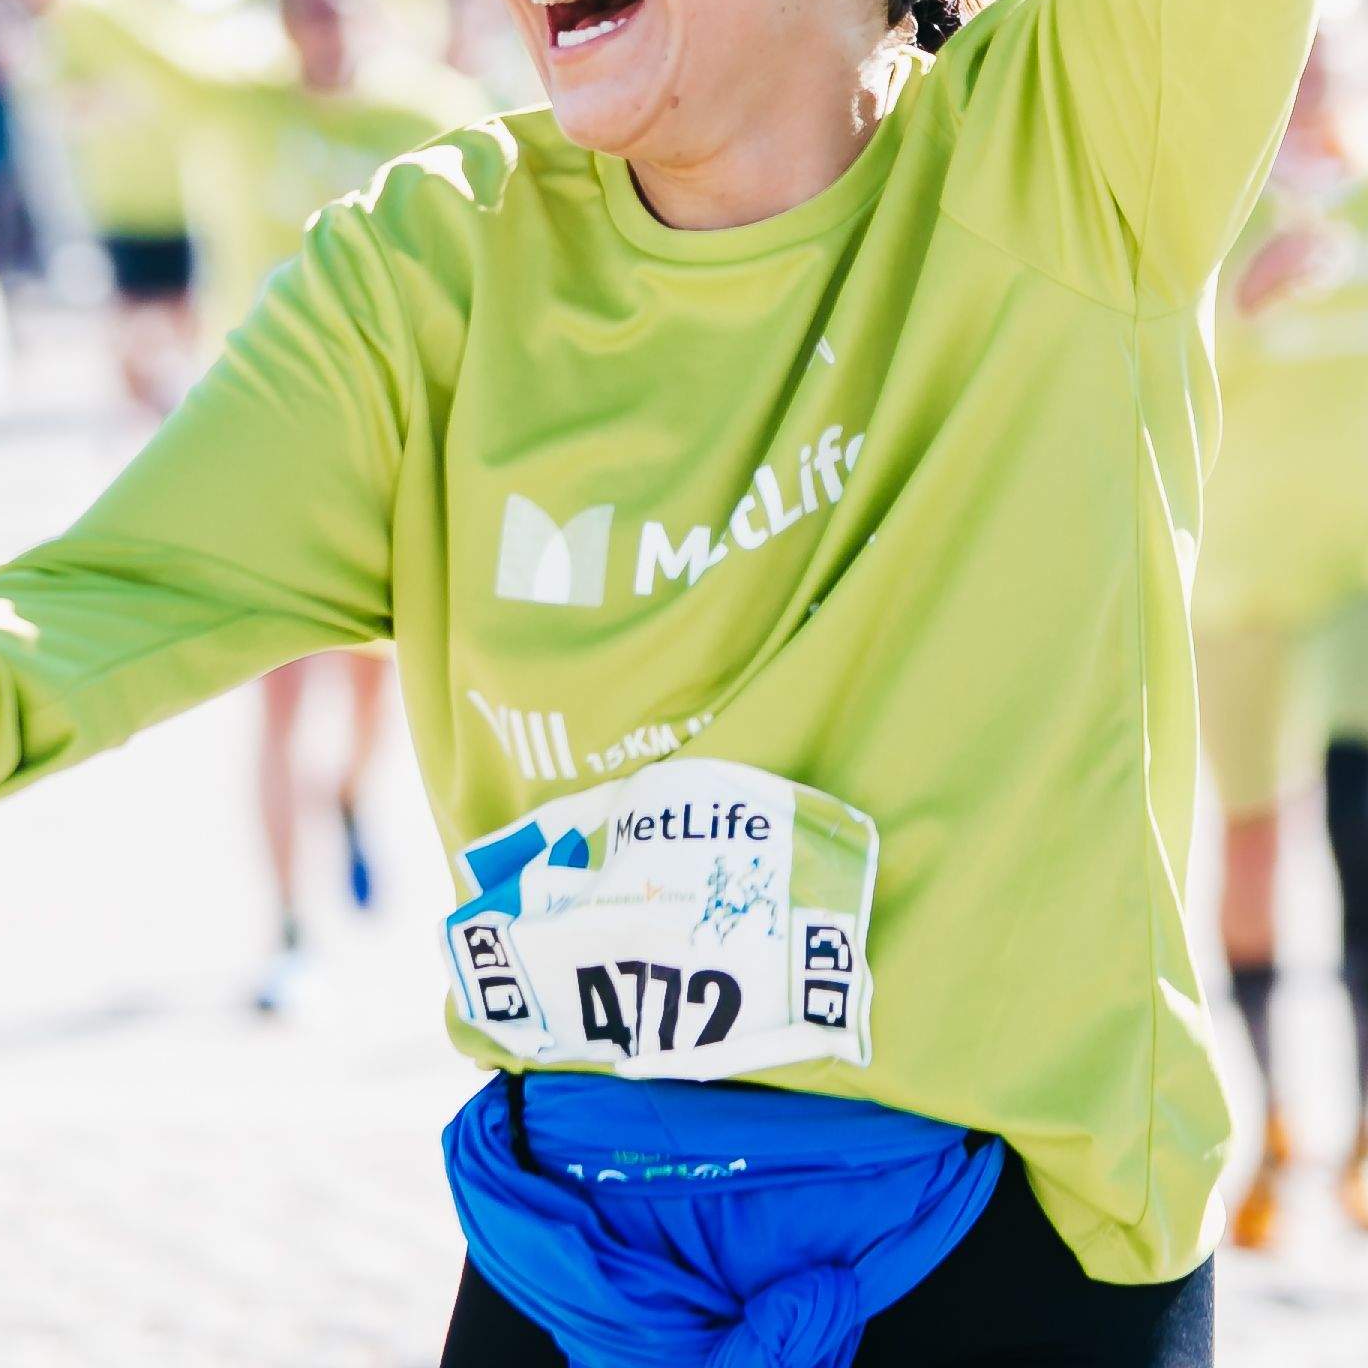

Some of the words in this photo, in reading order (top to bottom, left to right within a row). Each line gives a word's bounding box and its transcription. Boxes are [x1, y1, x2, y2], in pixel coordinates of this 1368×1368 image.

[634, 425, 866, 596] MtLif
[608, 802, 771, 856] MetLife
[575, 960, 742, 1059] 4772
